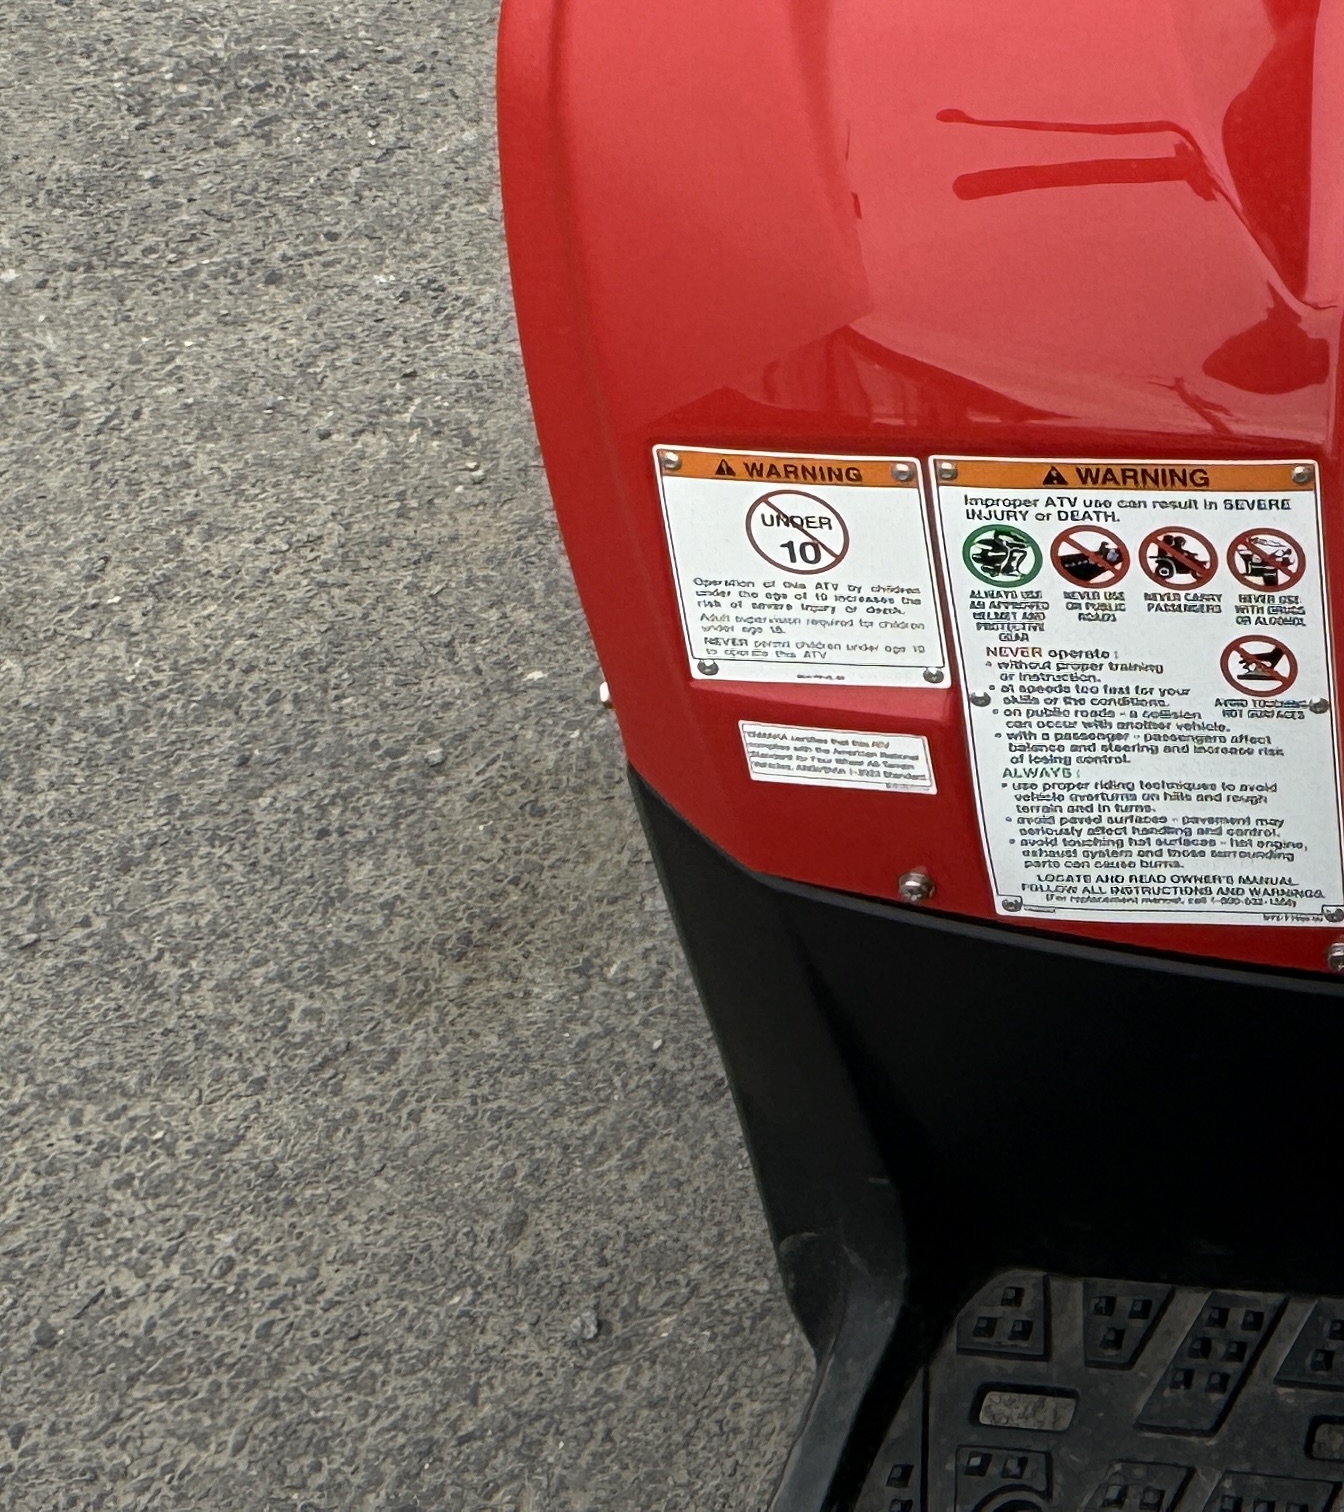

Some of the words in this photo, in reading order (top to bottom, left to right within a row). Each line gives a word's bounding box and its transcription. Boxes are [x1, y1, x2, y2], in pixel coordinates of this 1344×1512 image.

[742, 461, 864, 483] WARNING
[1075, 466, 1211, 488] WARNING
[963, 494, 1040, 510] Improper
[1044, 496, 1078, 508] ATV
[1116, 499, 1148, 509] can
[1151, 498, 1199, 511] result
[1203, 498, 1218, 511] in
[1222, 498, 1292, 511] SEVERE
[760, 513, 833, 531] UNDER
[965, 508, 1029, 522] INJURY
[1034, 512, 1053, 522] or
[1056, 509, 1121, 523] DEATH.
[779, 540, 823, 565] 10
[985, 646, 1043, 658] NEVER
